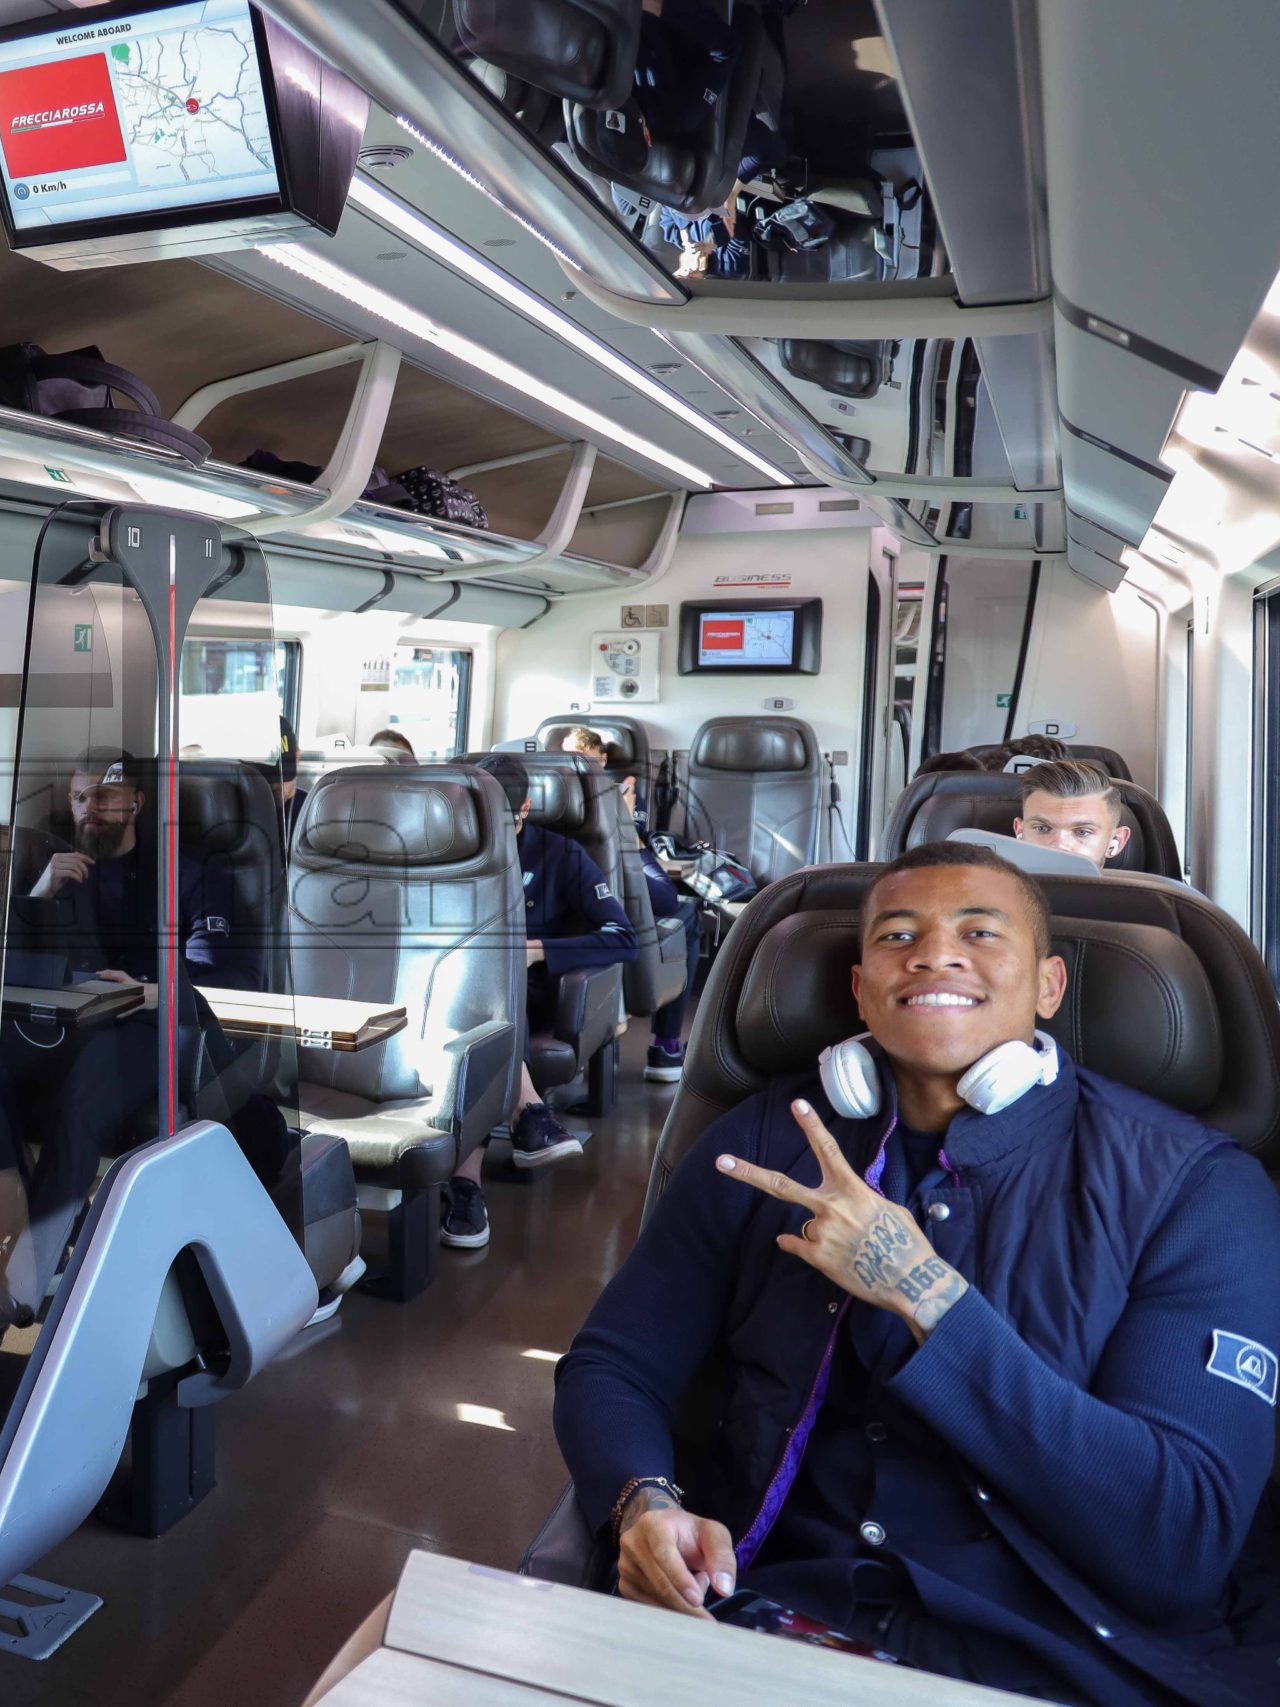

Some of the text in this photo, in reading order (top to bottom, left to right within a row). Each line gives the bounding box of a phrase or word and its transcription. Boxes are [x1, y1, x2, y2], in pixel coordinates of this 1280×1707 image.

[56, 23, 132, 46] WELCOME ABOARD
[11, 101, 105, 128] FRECCIAROSSA
[32, 181, 67, 194] 0 Km/h
[127, 526, 140, 548] 10
[205, 538, 212, 558] 11
[714, 573, 792, 583] BUSINESS
[774, 699, 785, 709] B
[1045, 723, 1059, 735] D
